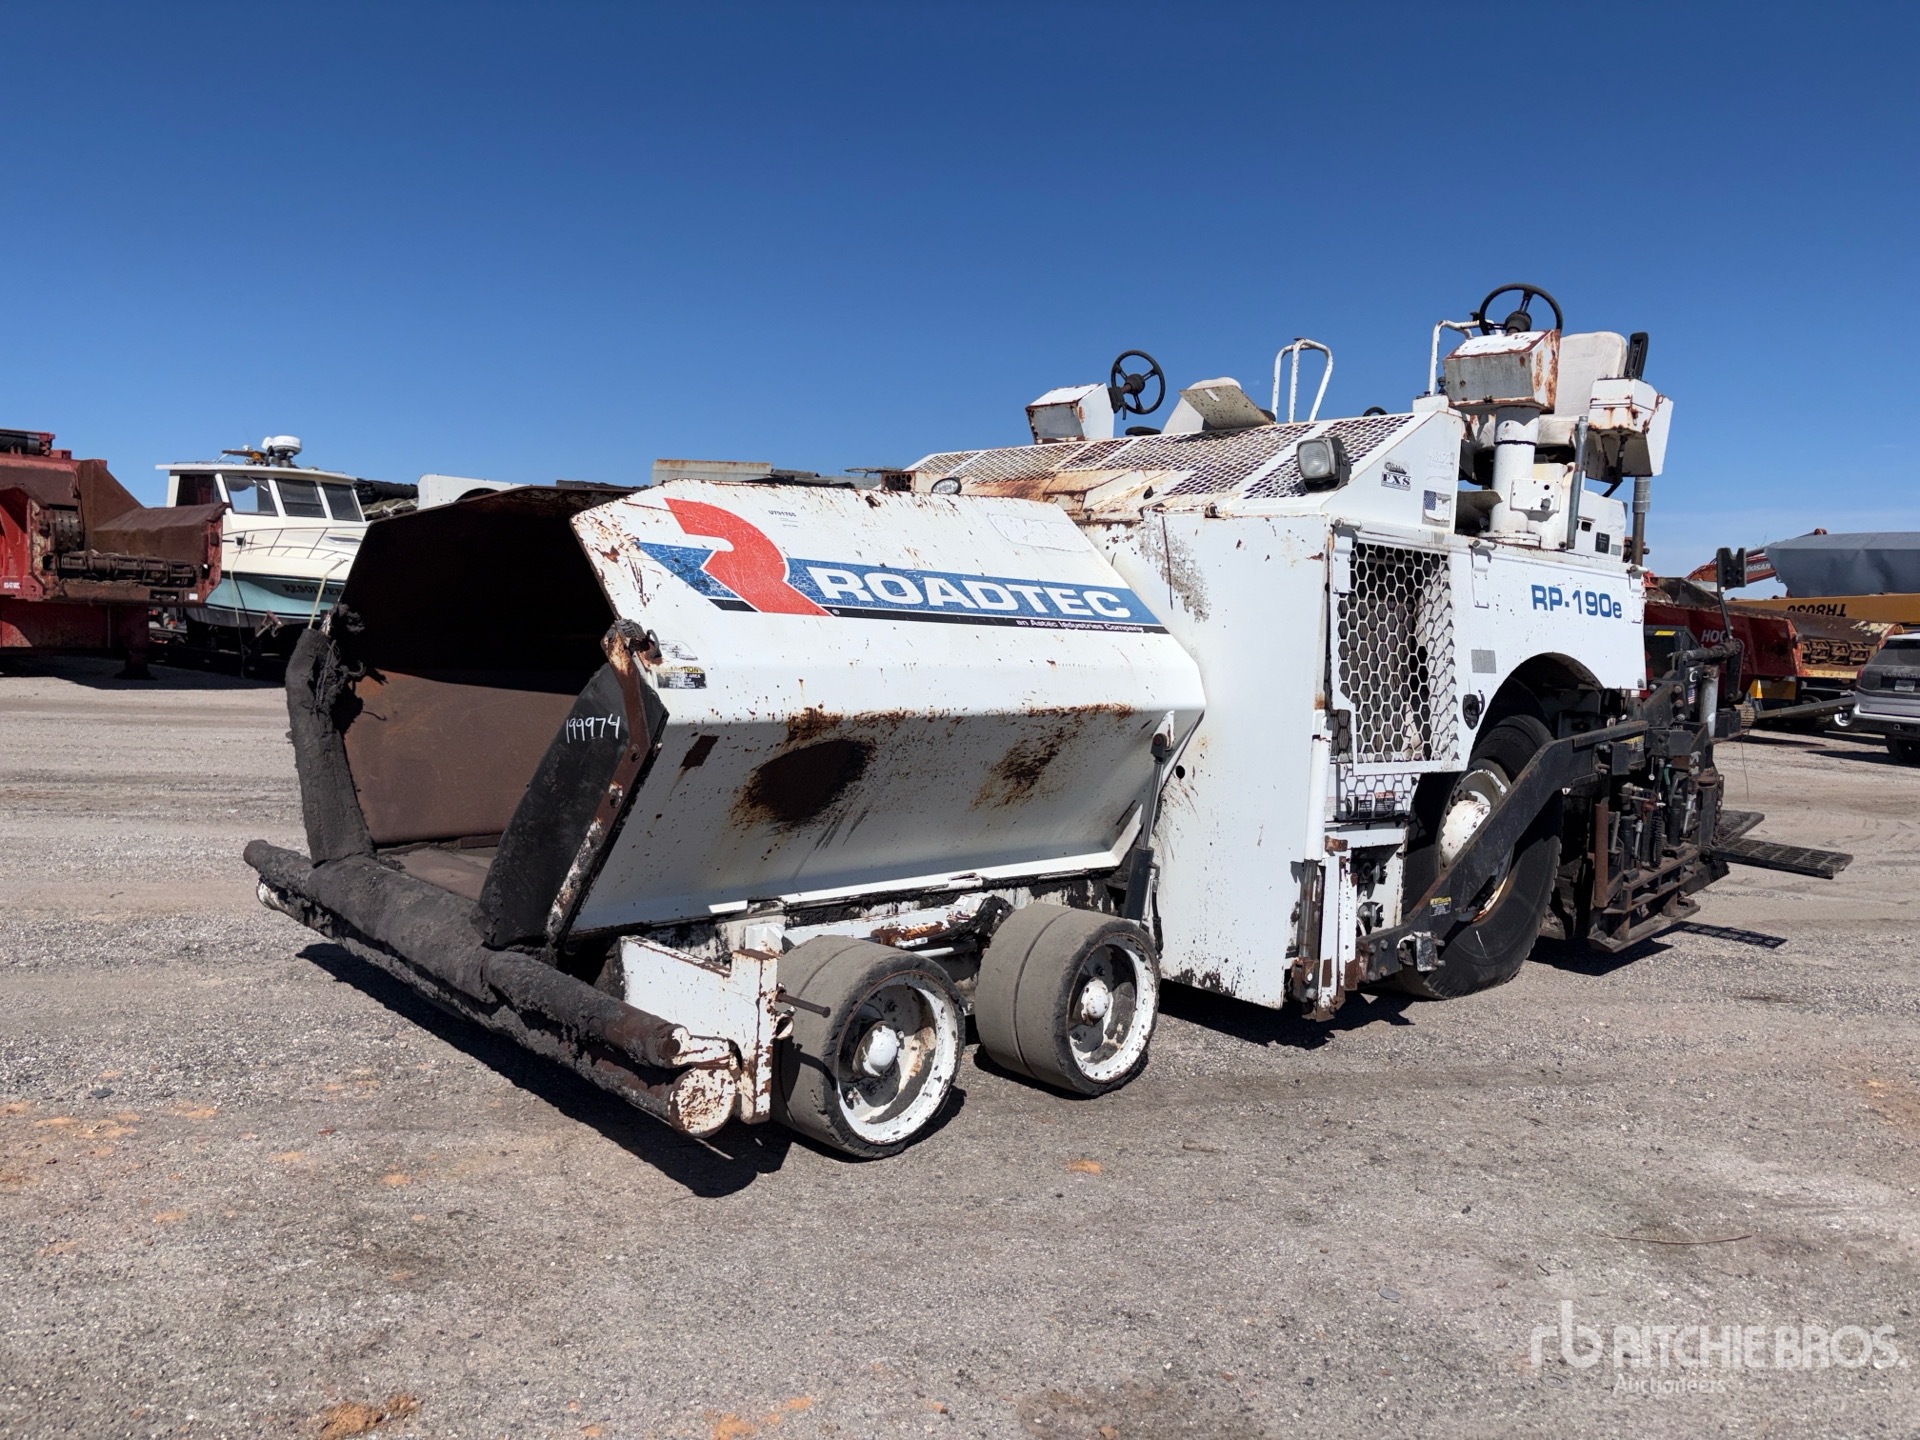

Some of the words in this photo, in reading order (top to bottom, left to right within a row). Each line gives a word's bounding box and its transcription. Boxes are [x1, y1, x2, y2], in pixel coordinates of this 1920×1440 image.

[806, 565, 1132, 619] ROADTEC
[1530, 584, 1622, 619] RP-190e
[1030, 619, 1058, 628] Astec
[1104, 623, 1144, 633] Company
[565, 713, 621, 744] 199974
